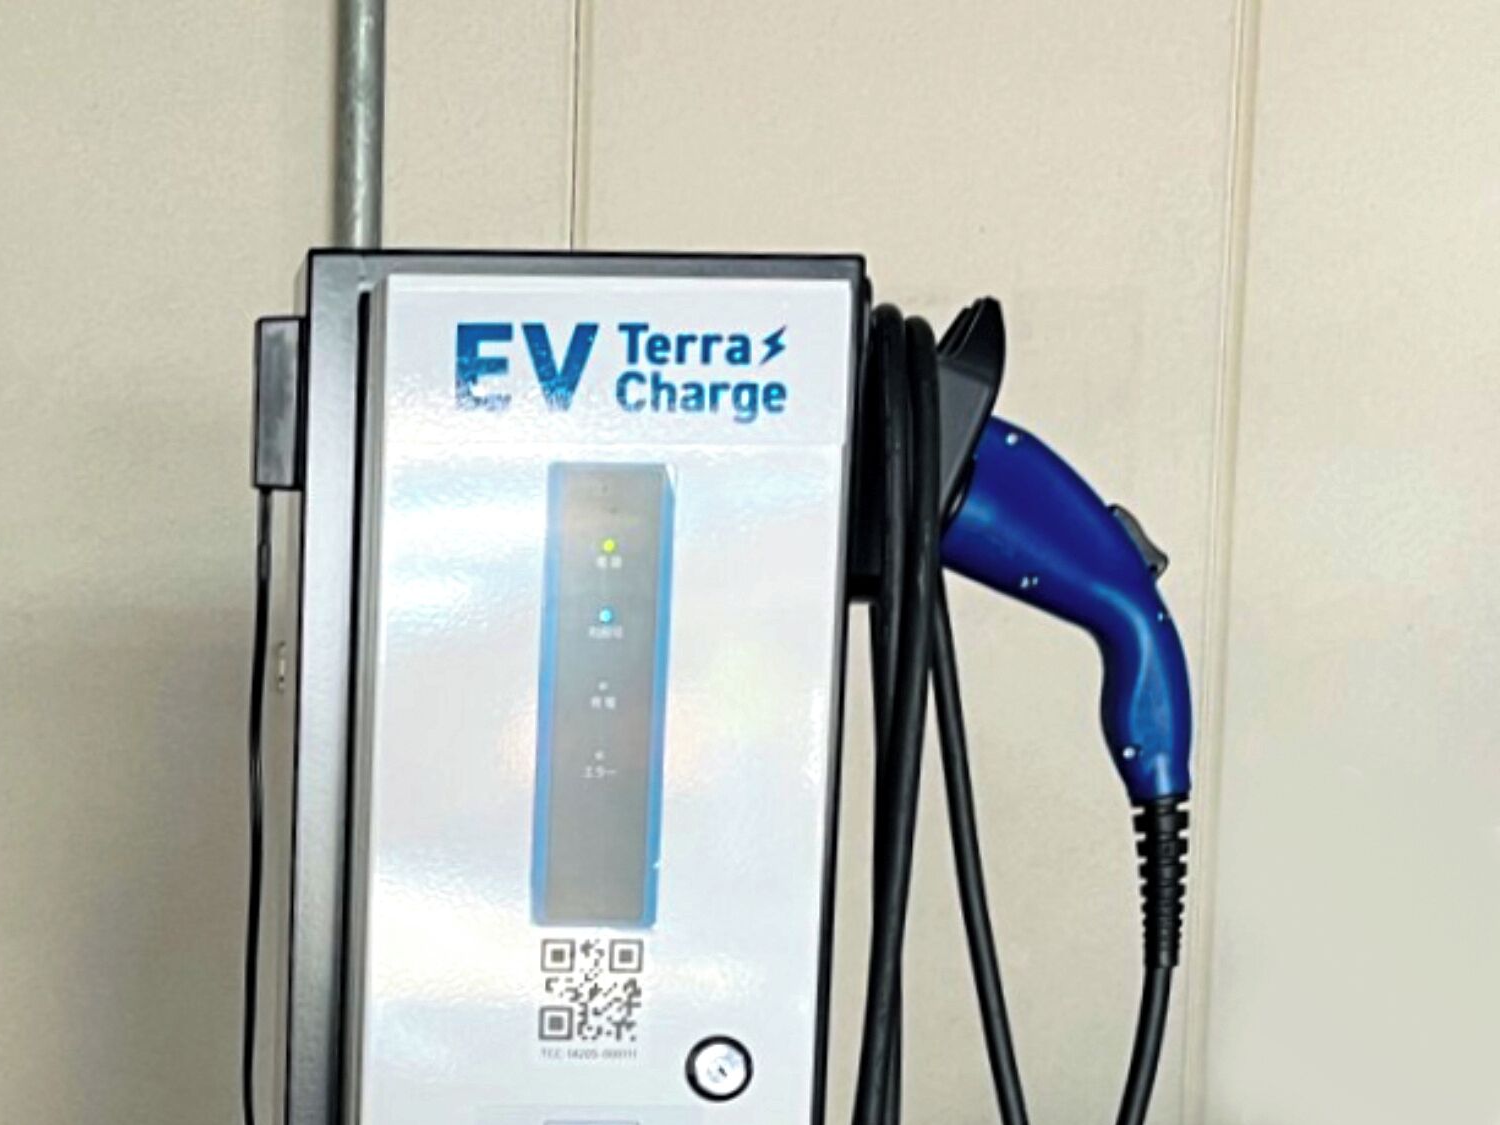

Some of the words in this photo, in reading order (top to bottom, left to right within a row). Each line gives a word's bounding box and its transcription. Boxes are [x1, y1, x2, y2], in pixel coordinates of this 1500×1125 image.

[455, 322, 600, 411] EV
[618, 322, 752, 365] Terra
[615, 371, 788, 424] Charge
